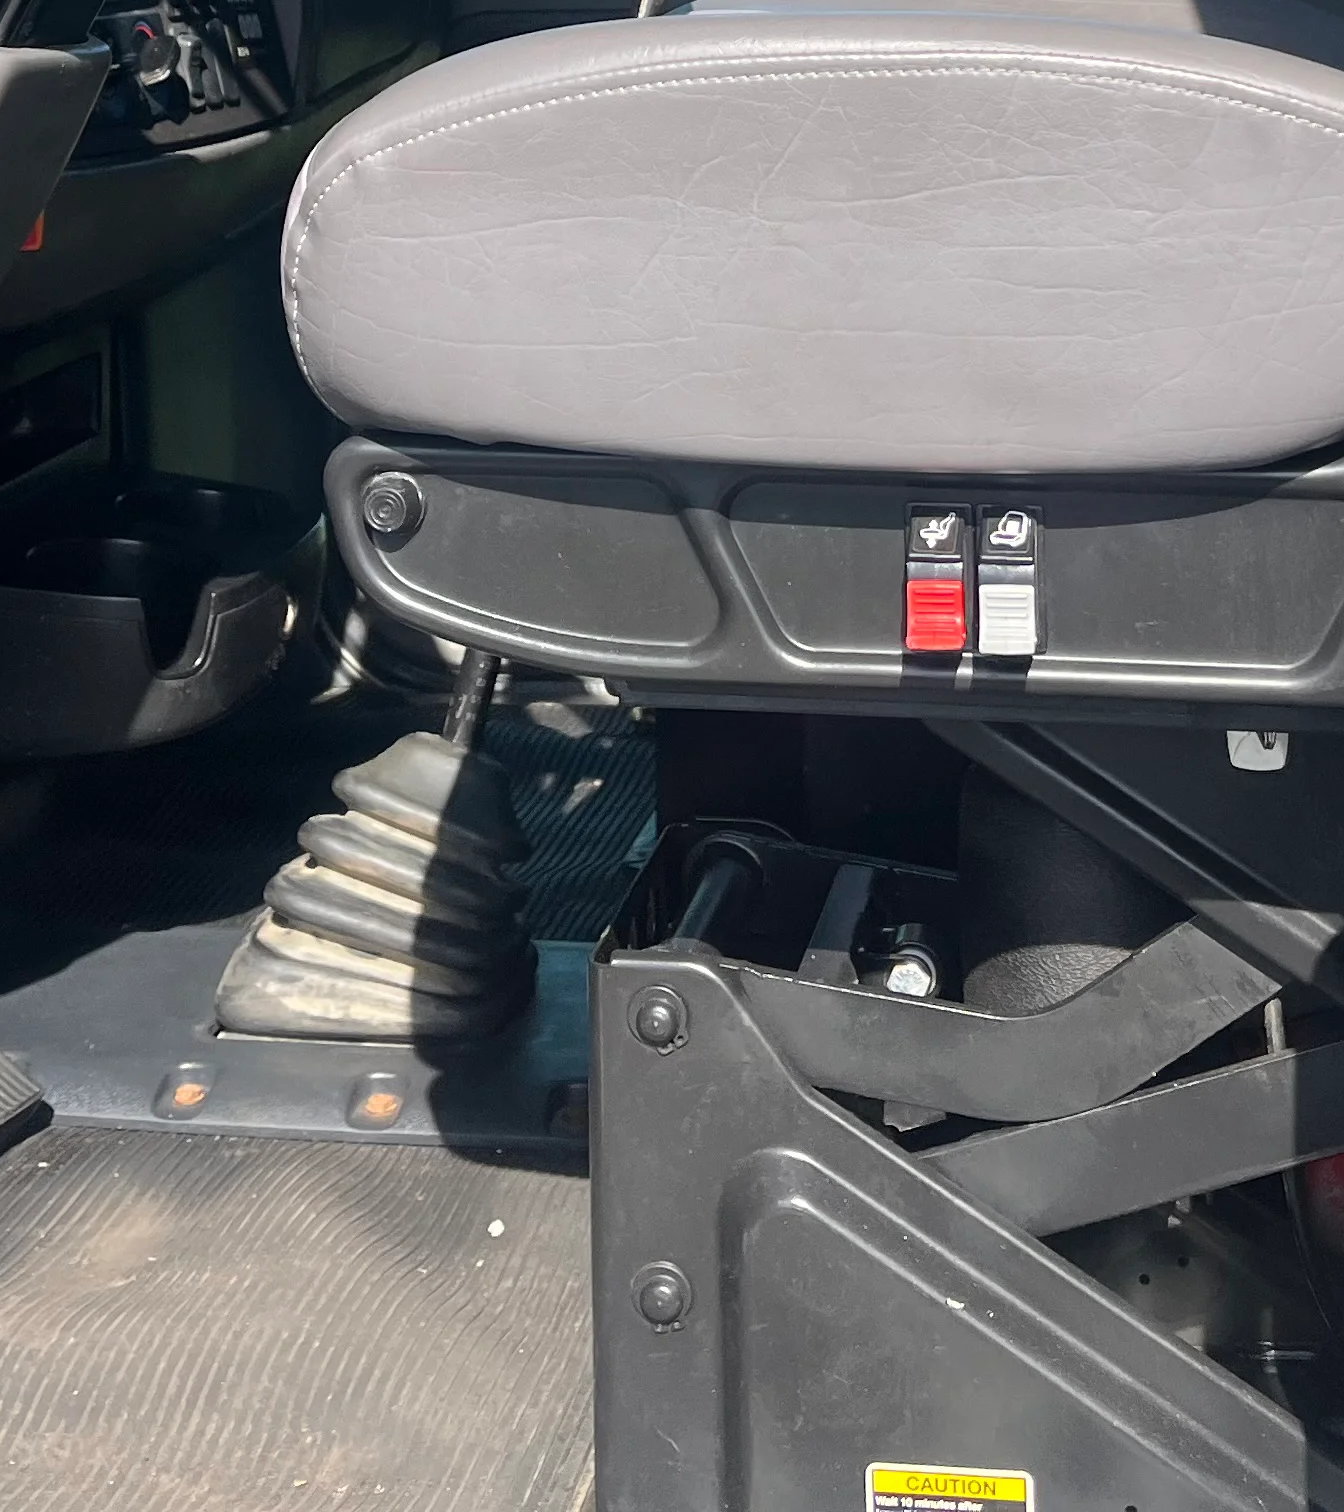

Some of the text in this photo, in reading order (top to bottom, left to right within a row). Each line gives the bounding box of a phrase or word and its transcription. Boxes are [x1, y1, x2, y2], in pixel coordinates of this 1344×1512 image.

[906, 1476, 996, 1496] CAUTION
[875, 1496, 983, 1512] Wait 10 minutes after
